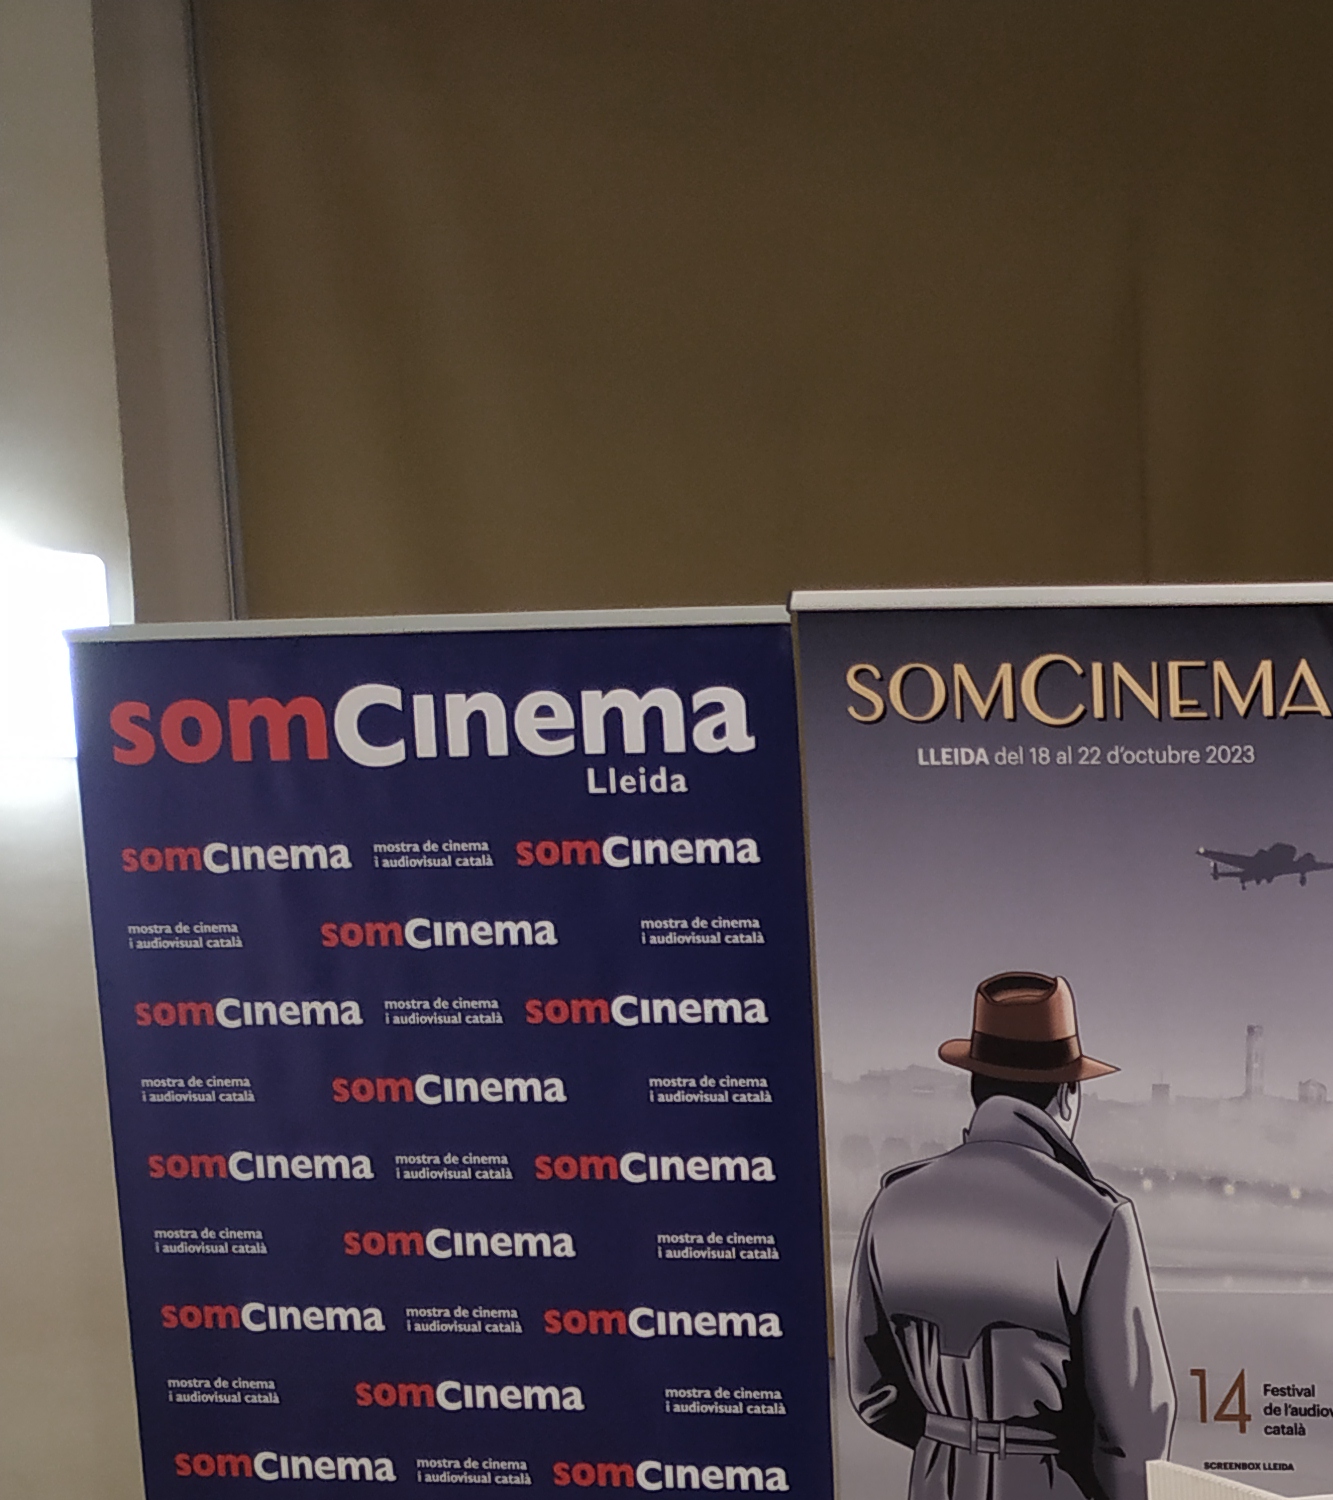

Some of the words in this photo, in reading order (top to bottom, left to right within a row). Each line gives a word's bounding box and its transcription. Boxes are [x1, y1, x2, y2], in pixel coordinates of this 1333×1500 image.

[109, 683, 756, 768] somCinema
[917, 747, 989, 766] LLEIDA
[994, 746, 1024, 765] del
[1029, 746, 1051, 765] 18
[1055, 745, 1073, 765] al
[1077, 746, 1101, 765] 22
[1106, 745, 1200, 765] d'octubre
[1205, 745, 1255, 764] 2023
[586, 767, 688, 795] Lleida
[372, 841, 420, 853] mostra
[421, 838, 439, 852] de
[440, 838, 489, 852] cinema
[514, 833, 761, 868] somCinema
[120, 841, 353, 873] somCinema
[373, 854, 379, 868] i
[381, 853, 452, 868] audiovisual
[454, 853, 494, 867] català
[126, 923, 173, 934] mostra
[173, 921, 190, 934] de
[192, 920, 239, 933] cinema
[639, 917, 689, 929] mostra
[690, 915, 708, 929] de
[709, 915, 760, 929] cinema
[319, 916, 558, 949] somCinema
[640, 930, 646, 944] i
[648, 930, 721, 944] audiovisual
[723, 930, 765, 944] català
[128, 936, 134, 948] i
[135, 935, 203, 949] audiovisual
[205, 935, 243, 948] català
[383, 998, 431, 1010] mostra
[432, 996, 449, 1009] de
[451, 995, 499, 1009] cinema
[524, 993, 769, 1026] somCinema
[133, 997, 364, 1028] somCinema
[384, 1011, 390, 1024] i
[391, 1010, 462, 1024] audiovisual
[464, 1010, 503, 1024] català
[140, 1077, 185, 1088] mostra
[186, 1074, 203, 1087] de
[205, 1075, 251, 1087] cinema
[140, 1090, 147, 1102] i
[148, 1089, 216, 1102] audiovisual
[217, 1089, 255, 1102] català
[331, 1073, 567, 1105] somCinema
[146, 1149, 374, 1181] somCinema
[394, 1153, 441, 1165] mostra
[442, 1151, 459, 1165] de
[460, 1151, 509, 1165] cinema
[395, 1166, 401, 1179] i
[402, 1166, 472, 1179] audiovisual
[474, 1166, 513, 1180] català
[533, 1150, 776, 1183] somCinema
[342, 1226, 577, 1259] somCinema
[656, 1232, 704, 1244] mostra
[705, 1230, 723, 1244] de
[725, 1230, 775, 1245] cinema
[656, 1244, 662, 1258] i
[664, 1245, 736, 1259] audiovisual
[738, 1246, 780, 1260] català
[159, 1301, 386, 1332] somCinema
[405, 1306, 451, 1318] mostra
[452, 1305, 469, 1318] de
[471, 1305, 518, 1319] cinema
[406, 1318, 411, 1332] i
[413, 1319, 482, 1333] audiovisual
[484, 1320, 523, 1333] català
[542, 1306, 783, 1338] somCinema
[166, 1377, 211, 1388] mostra
[212, 1375, 229, 1388] de
[231, 1376, 275, 1389] cinema
[167, 1389, 173, 1402] i
[175, 1389, 242, 1403] audiovisual
[243, 1391, 280, 1404] català
[353, 1379, 585, 1411] somCinema
[664, 1386, 712, 1398] mostra
[713, 1385, 731, 1399] de
[732, 1386, 783, 1400] cinema
[1263, 1383, 1316, 1398] Festival
[664, 1399, 671, 1413] i
[672, 1399, 744, 1414] audiovisual
[745, 1401, 786, 1415] català
[1190, 1368, 1252, 1434] 14
[1263, 1403, 1282, 1416] de
[1264, 1422, 1306, 1436] català
[173, 1450, 397, 1482] somCinema
[1204, 1462, 1261, 1470] SCREENBOX
[1263, 1462, 1294, 1471] LLEIDA
[551, 1459, 790, 1491] somCinema
